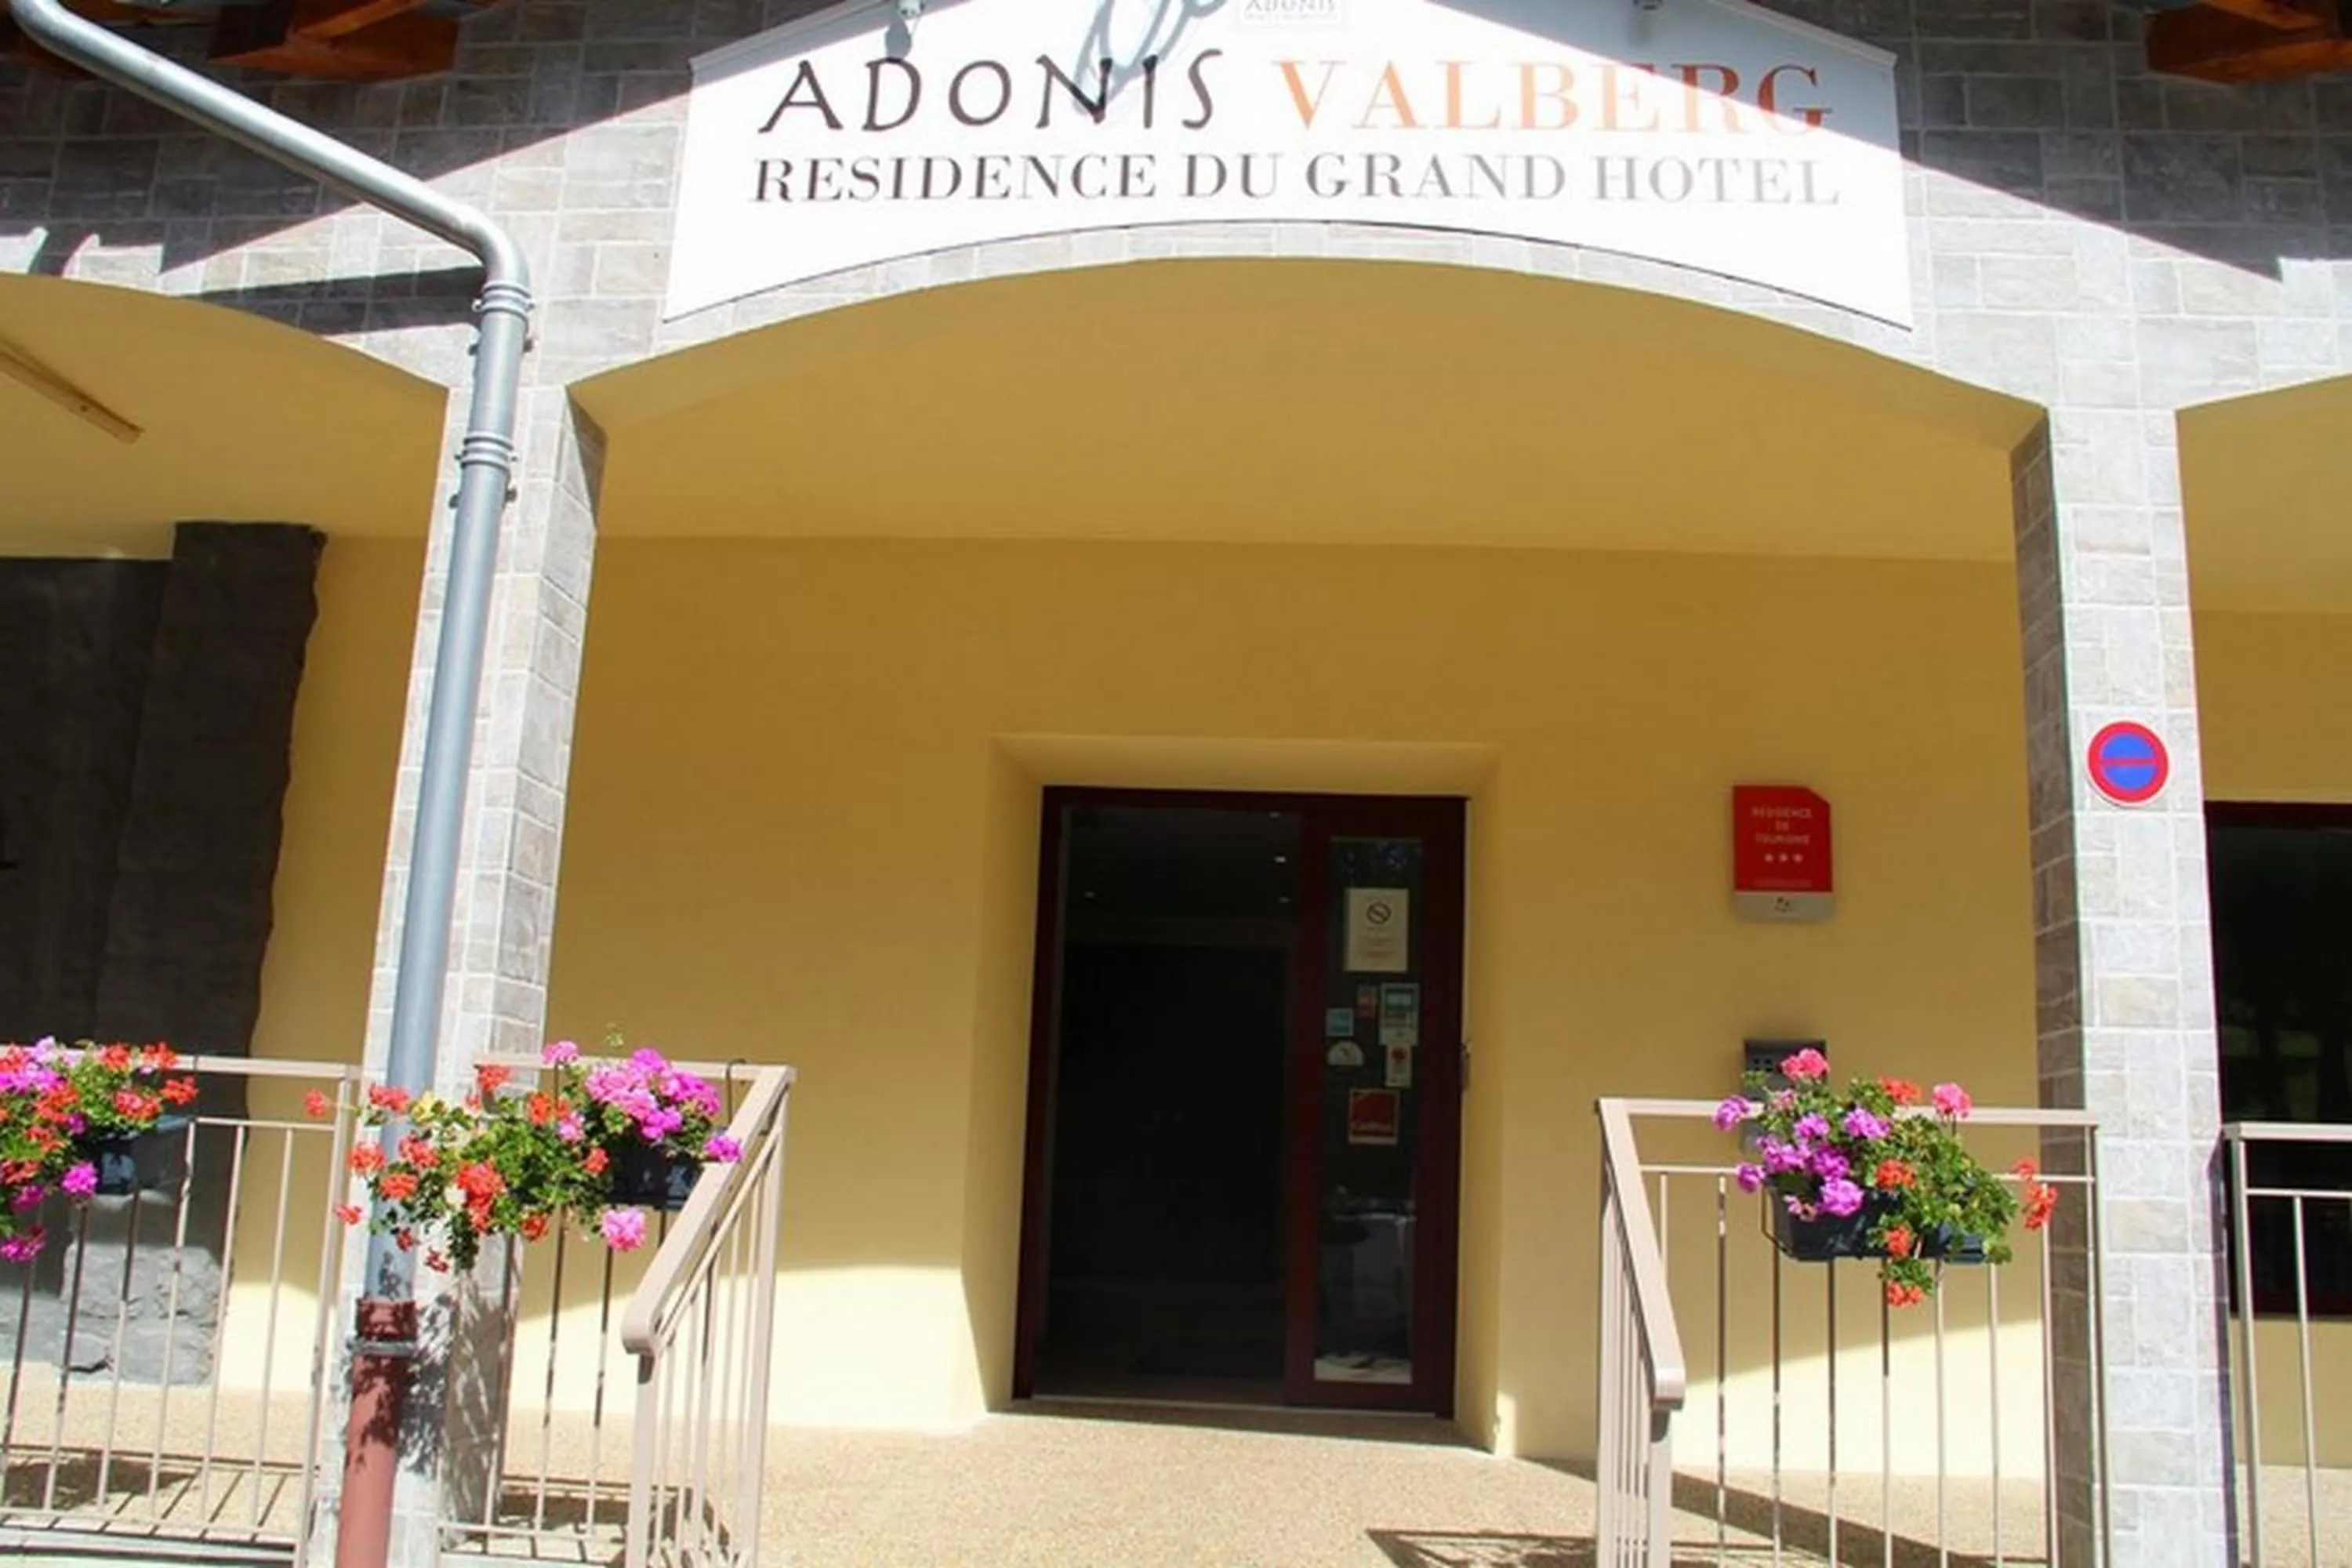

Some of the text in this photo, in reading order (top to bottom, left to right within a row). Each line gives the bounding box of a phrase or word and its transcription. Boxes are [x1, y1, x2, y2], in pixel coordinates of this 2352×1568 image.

[758, 49, 1833, 136] ADONIS VALBERG
[750, 153, 1840, 205] RESIDENCE DU GRAND HOTEL
